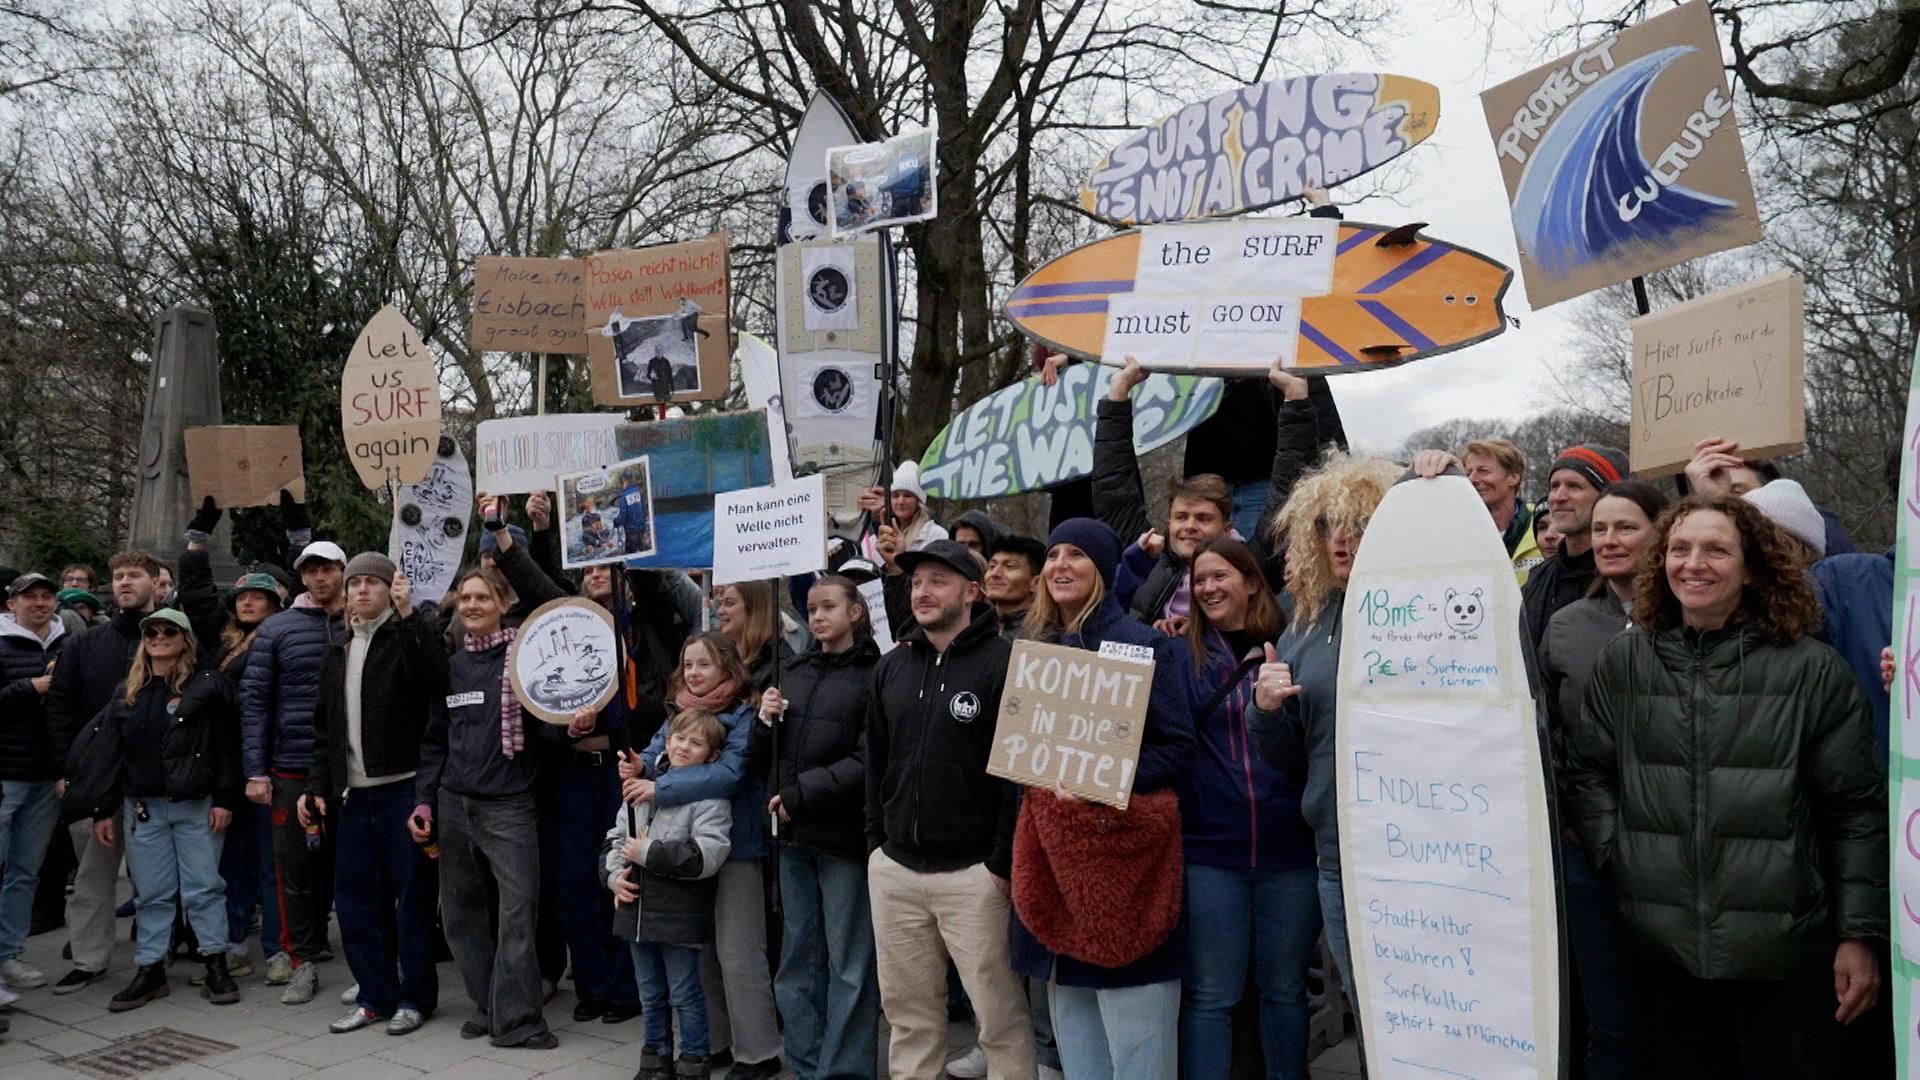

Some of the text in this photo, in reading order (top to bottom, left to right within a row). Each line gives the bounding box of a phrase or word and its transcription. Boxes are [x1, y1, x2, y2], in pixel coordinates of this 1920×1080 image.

[1619, 87, 1734, 222] CULTURE
[1140, 159, 1206, 219] NOT
[1204, 155, 1233, 211] A
[1161, 235, 1323, 265] the SURF
[496, 265, 582, 284] Make the
[591, 257, 633, 287] Posen
[640, 256, 675, 276] reicht
[477, 289, 585, 318] Eisbach
[630, 286, 652, 305] statt
[483, 325, 538, 345] great
[1114, 310, 1190, 334] must
[1213, 305, 1244, 323] GO
[1249, 305, 1283, 322] ON
[1645, 340, 1681, 366] Hier
[1734, 330, 1758, 345] nur
[371, 371, 403, 389] us
[353, 387, 431, 426] SURF
[945, 381, 1024, 458] LET
[1032, 366, 1091, 430] US
[355, 432, 429, 469] again
[920, 443, 1010, 497] THE
[728, 493, 811, 516] Man kann eine
[736, 513, 803, 534] Welle nicht
[738, 536, 801, 554] verwalten.
[1015, 653, 1143, 708] KOMMT
[1403, 656, 1418, 674] für
[1440, 675, 1483, 688] Surfer
[1354, 750, 1490, 816] ENDLESS
[1386, 822, 1502, 874] BUMMER
[1368, 899, 1473, 937] Stadtkultur
[1383, 975, 1481, 1014] Surfkultur
[1385, 1010, 1536, 1053] gehört zu München
